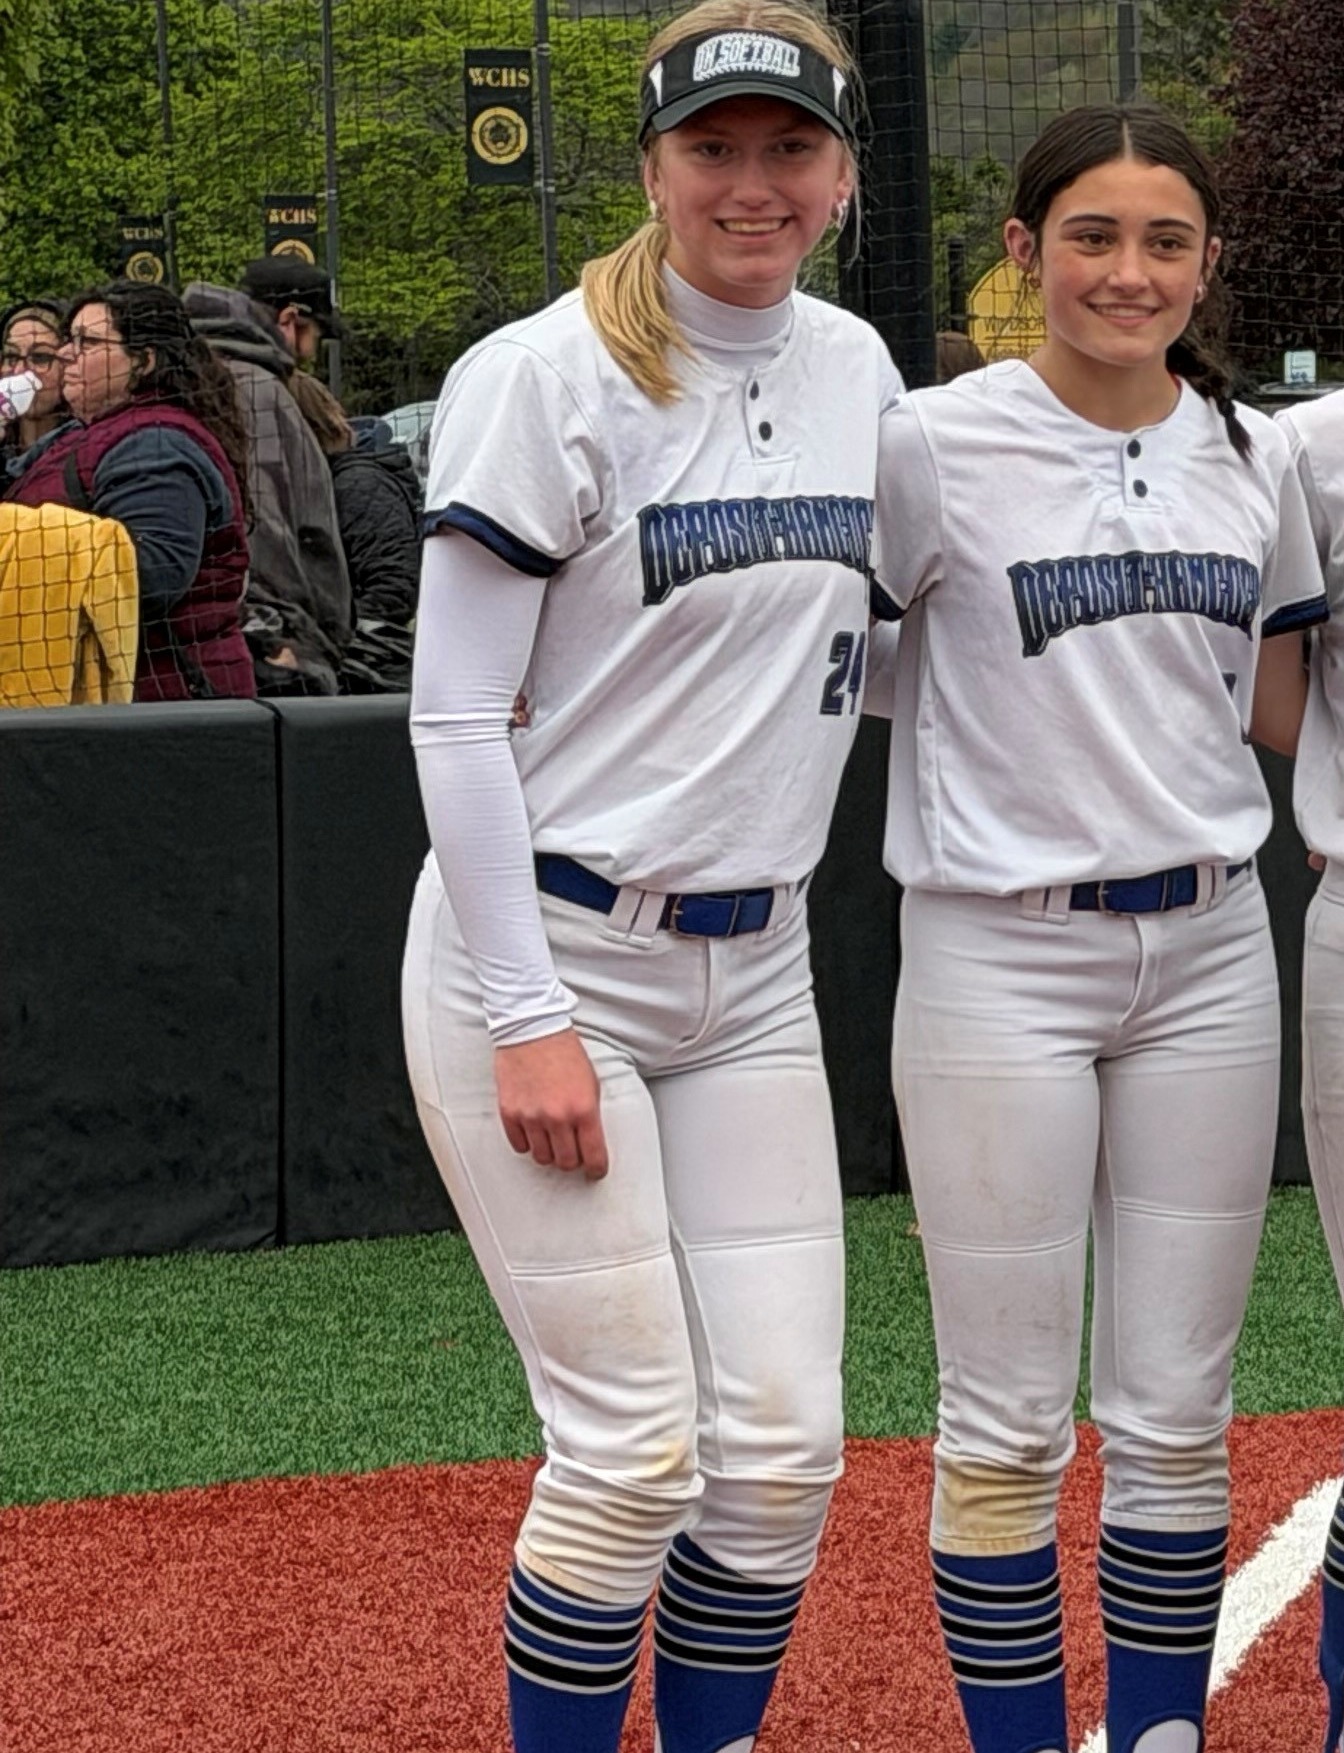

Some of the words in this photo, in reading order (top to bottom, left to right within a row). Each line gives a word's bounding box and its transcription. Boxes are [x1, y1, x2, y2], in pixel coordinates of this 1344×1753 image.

[716, 33, 801, 77] SOFTBALL
[468, 67, 530, 88] WCHS
[268, 208, 317, 225] WCHS
